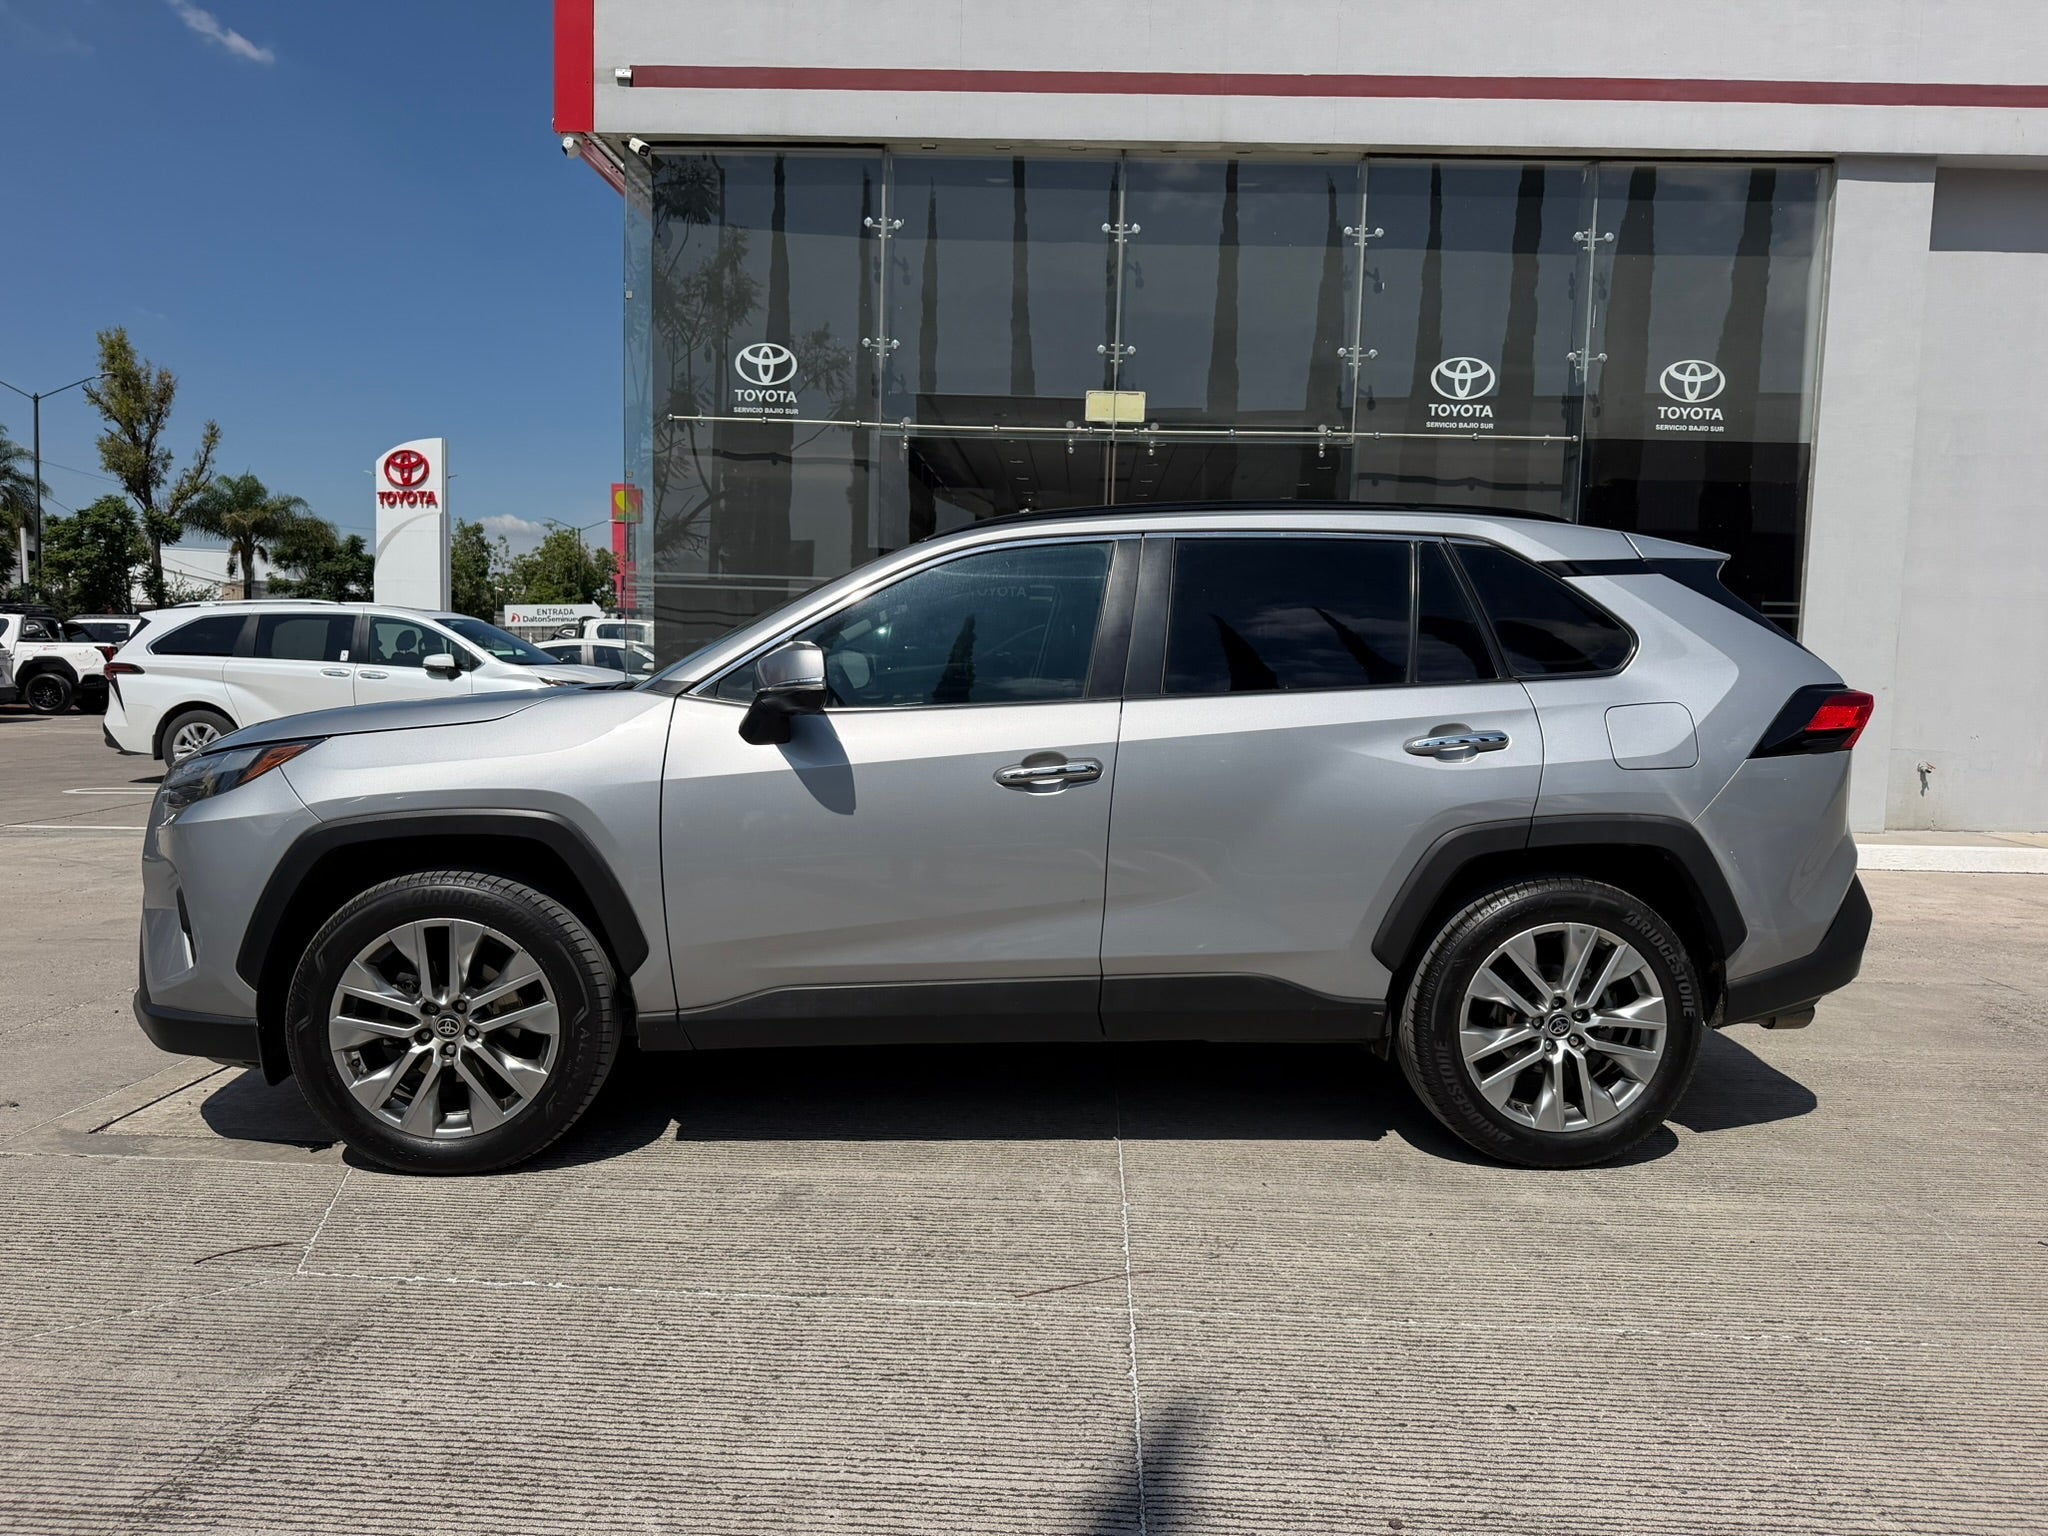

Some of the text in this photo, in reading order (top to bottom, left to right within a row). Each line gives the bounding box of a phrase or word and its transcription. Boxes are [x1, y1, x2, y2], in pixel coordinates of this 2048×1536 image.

[734, 389, 798, 403] TOYOTA
[733, 406, 764, 414] SERVICIO
[1428, 403, 1494, 418] TOYOTA
[1657, 406, 1724, 421] TOYOTA
[1426, 421, 1458, 429] SERVICIO
[1710, 425, 1725, 433] SUR
[377, 490, 439, 508] TOYOTA
[536, 608, 575, 616] ENTRADA
[1622, 910, 1697, 1017] BRIDGESTONE
[1433, 1039, 1515, 1143] BRIDGESTONE
